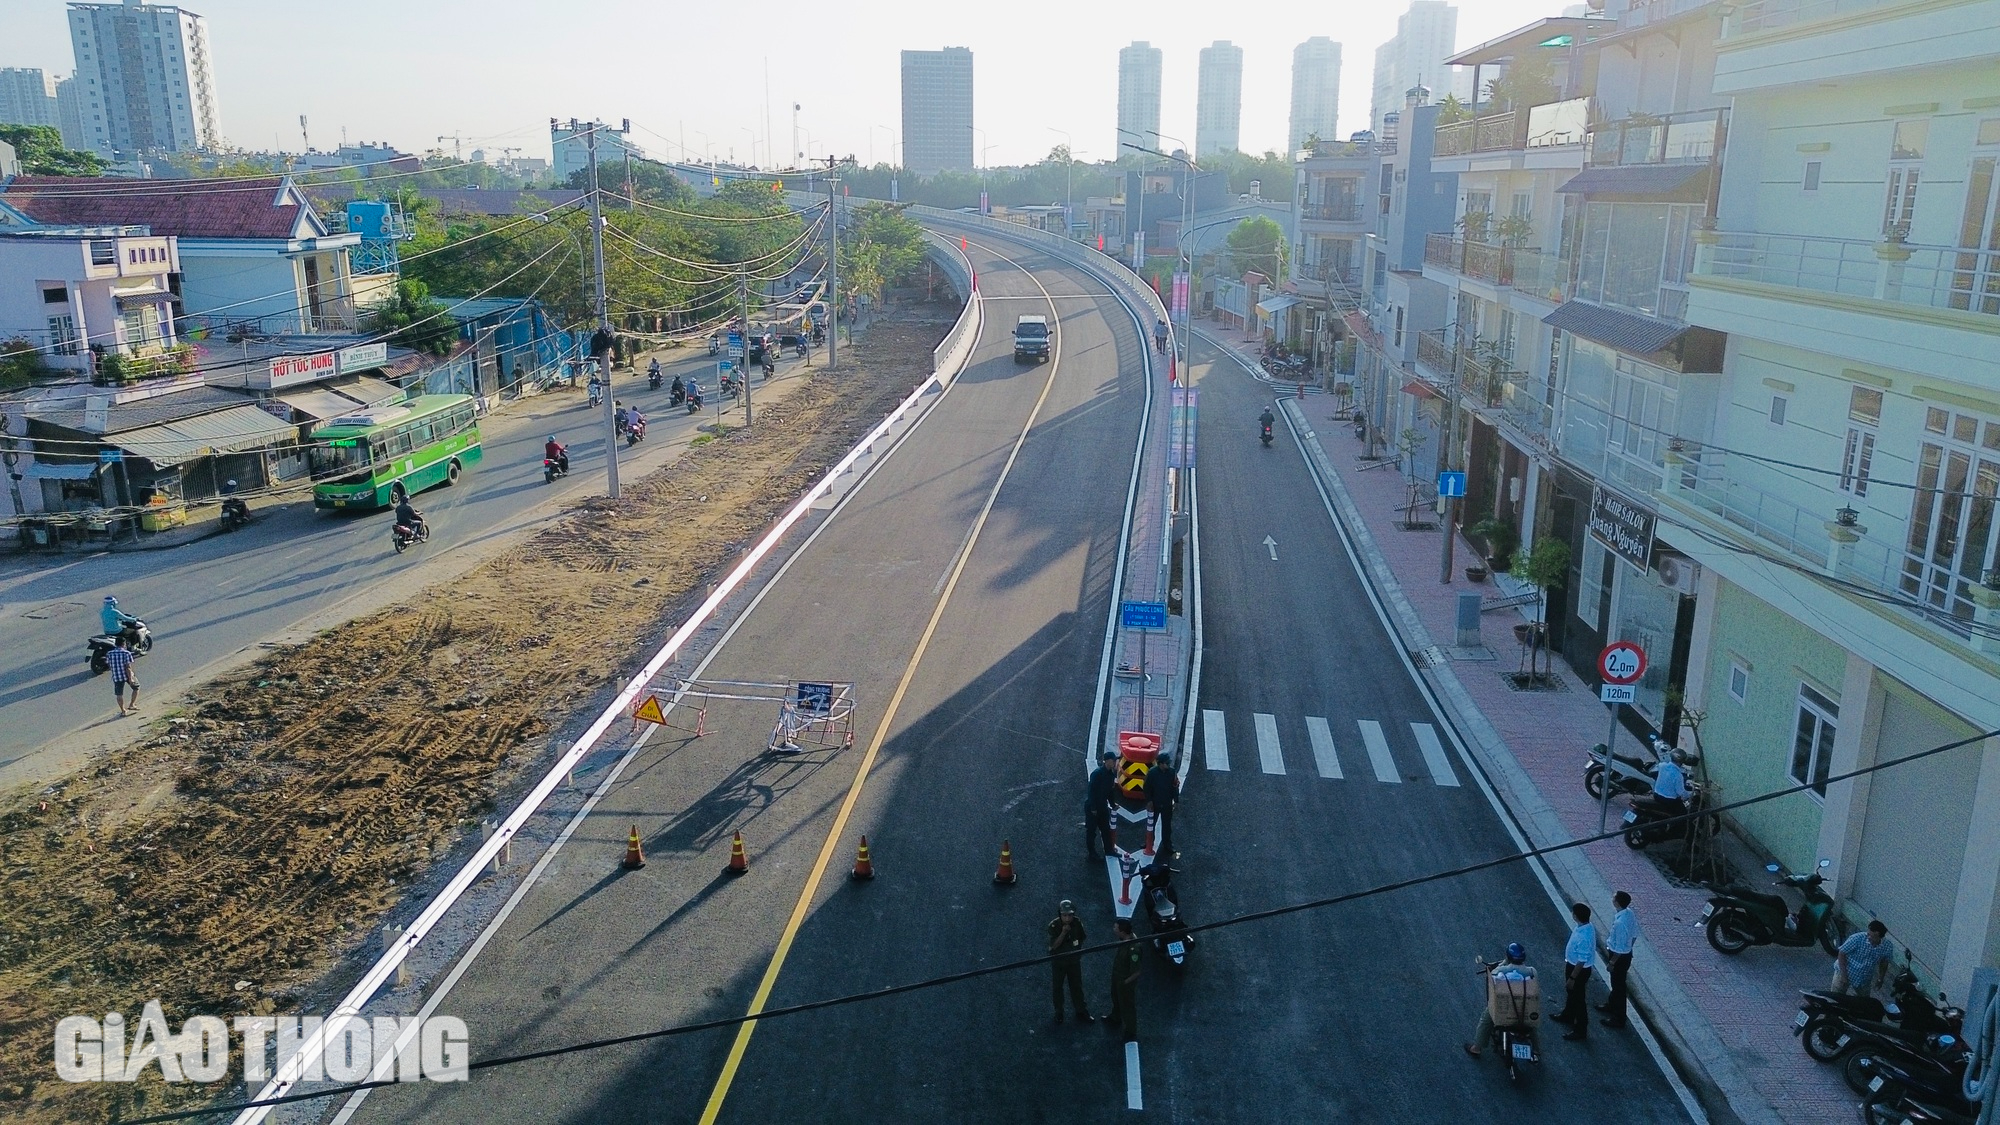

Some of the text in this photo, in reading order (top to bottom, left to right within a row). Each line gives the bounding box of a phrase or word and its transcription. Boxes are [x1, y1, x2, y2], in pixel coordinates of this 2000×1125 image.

[1589, 508, 1613, 542] Quang
[1605, 497, 1646, 531] HAIR SALON
[1606, 688, 1631, 699] 120m
